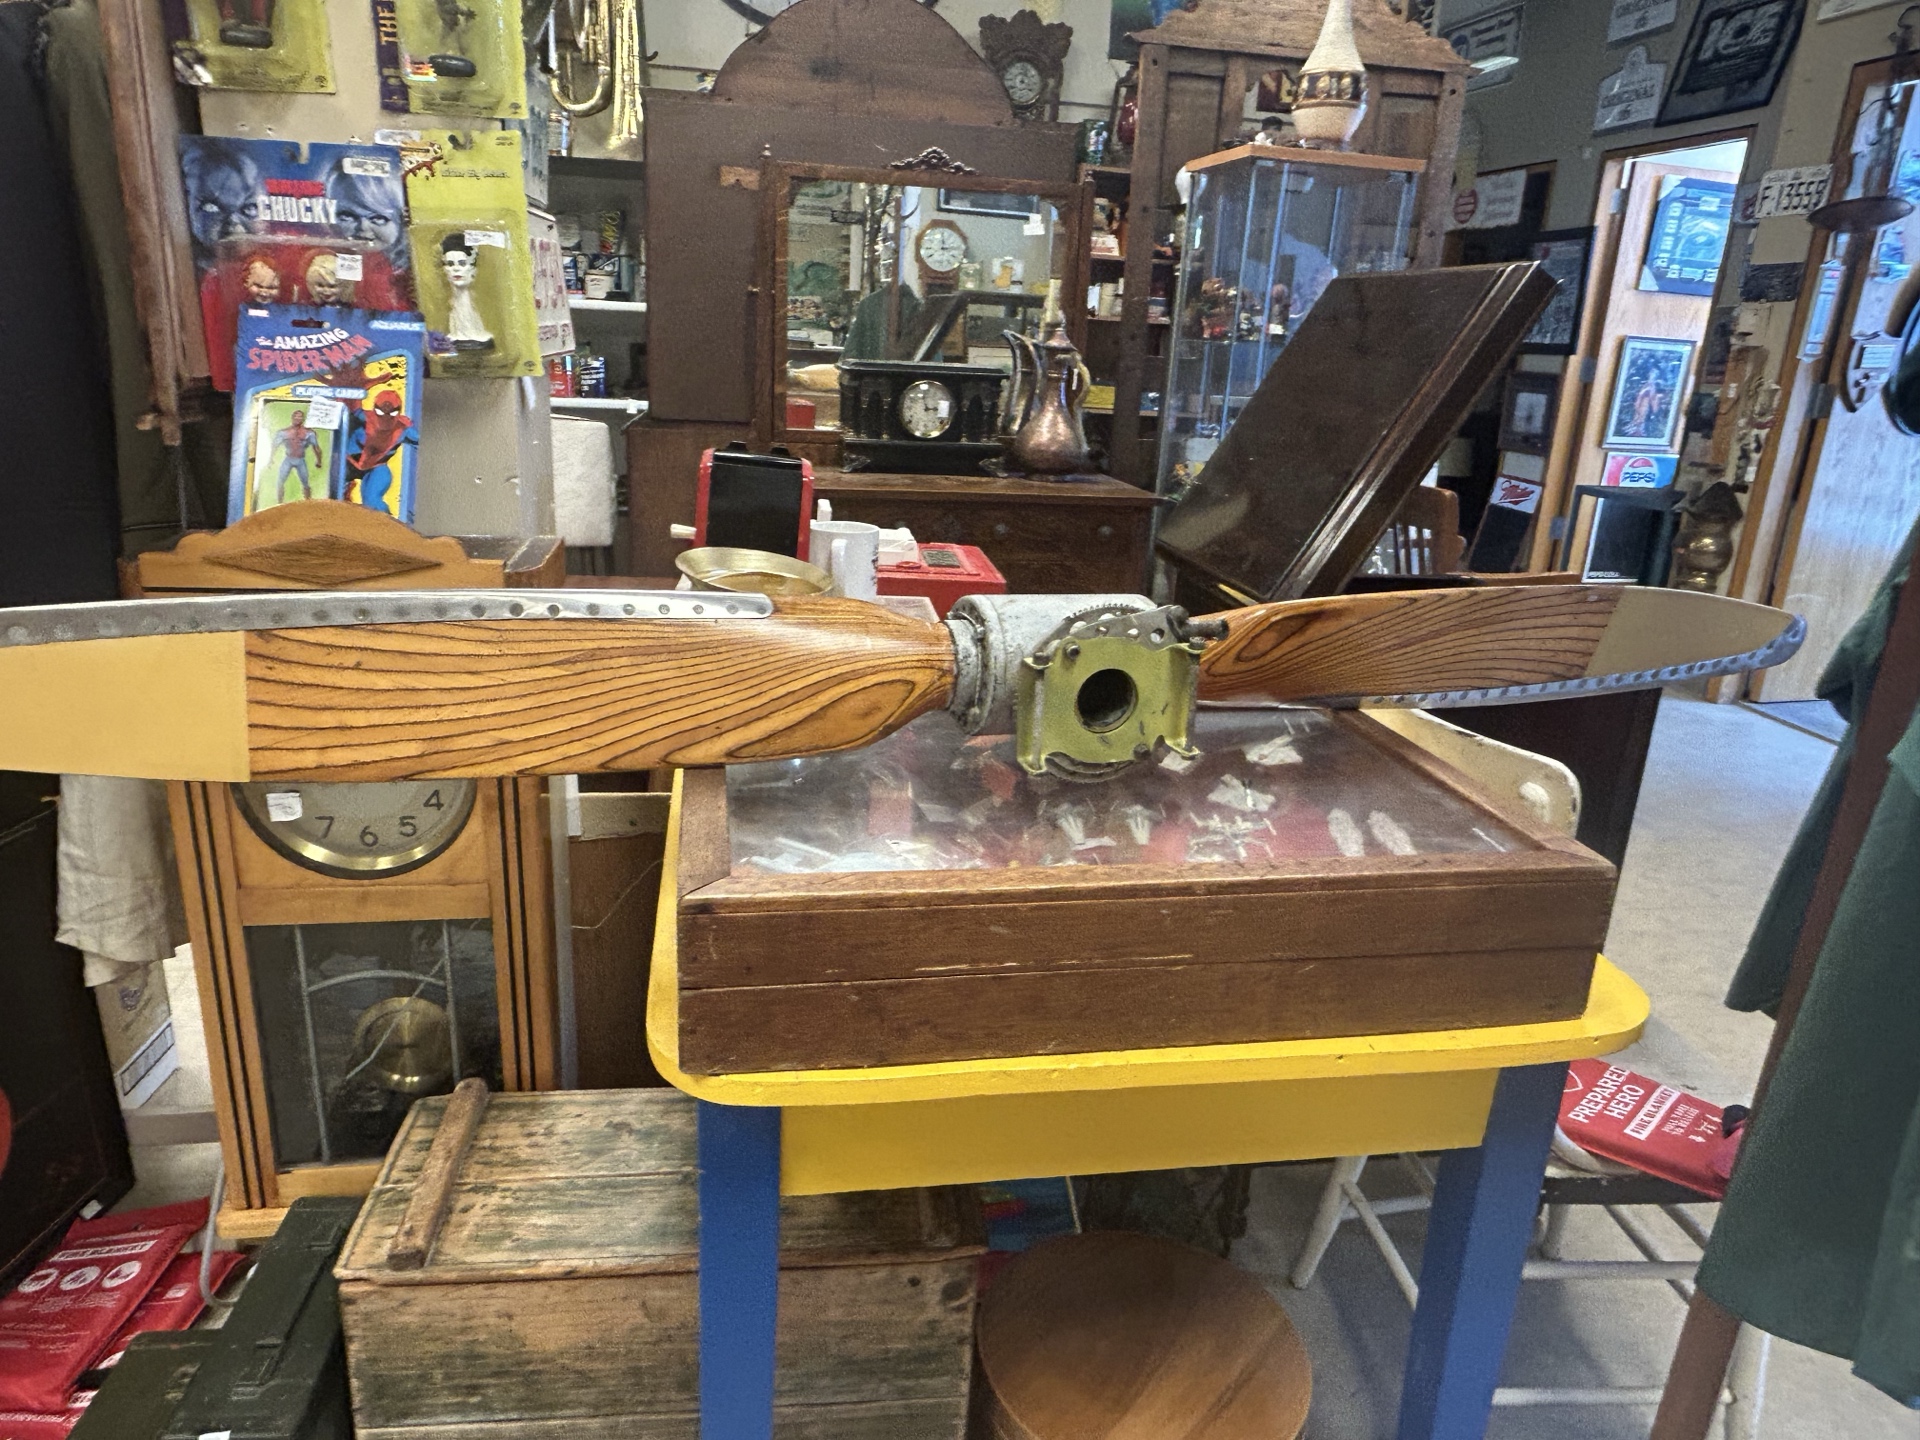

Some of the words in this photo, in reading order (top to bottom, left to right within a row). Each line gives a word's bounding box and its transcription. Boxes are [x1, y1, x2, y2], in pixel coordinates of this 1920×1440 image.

[377, 6, 399, 45] THE
[257, 195, 337, 223] CHUCKY
[273, 328, 349, 349] AMAZING
[246, 334, 373, 373] SPIDER-MAN
[1621, 472, 1656, 483] PEPSI
[423, 790, 444, 811] 4
[315, 816, 334, 839] 7
[359, 826, 379, 847] 6
[400, 816, 417, 837] 5
[1568, 1065, 1631, 1123] PREPARED
[1604, 1085, 1645, 1119] HERO
[1630, 1116, 1651, 1135] FIRE
[1646, 1088, 1676, 1119] BLANKET
